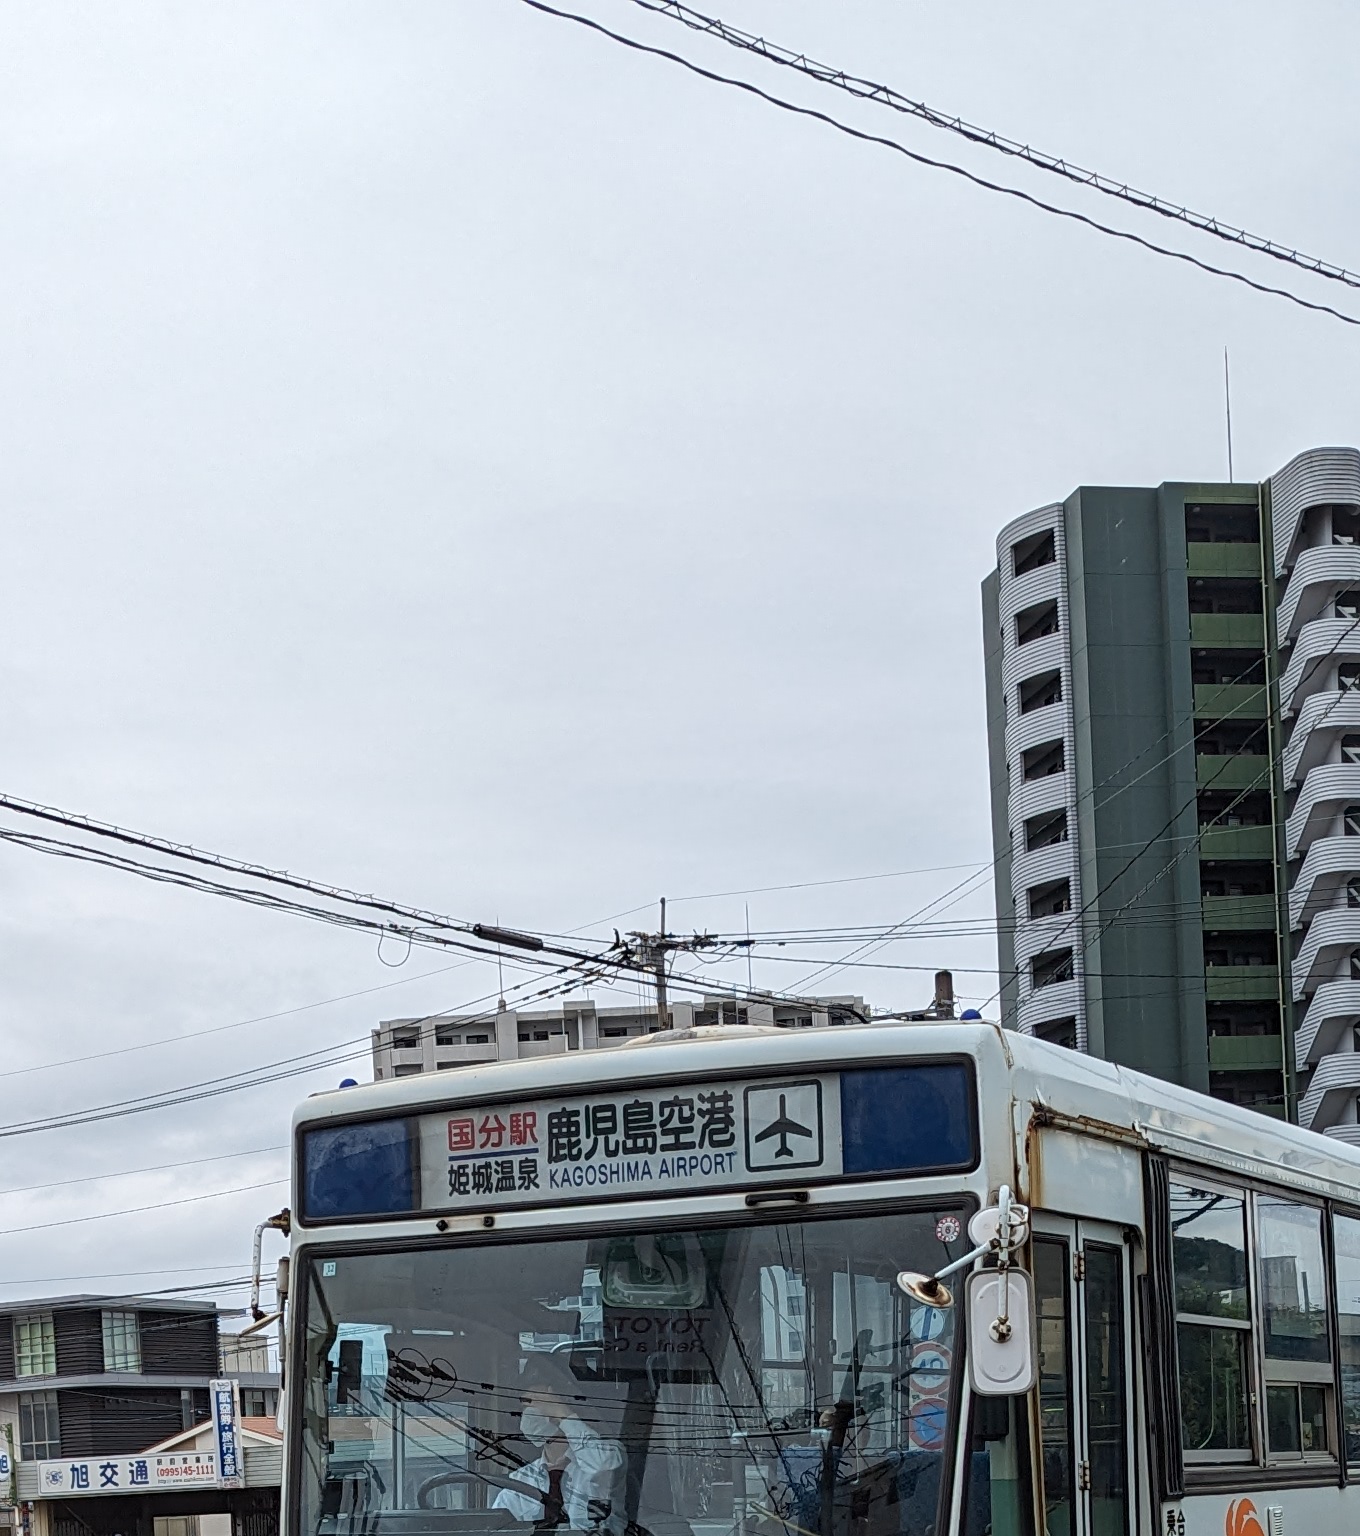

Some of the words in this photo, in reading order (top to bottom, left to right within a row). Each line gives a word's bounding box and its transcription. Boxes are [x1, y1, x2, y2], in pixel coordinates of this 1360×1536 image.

[447, 1111, 538, 1152] 国分駅
[546, 1090, 736, 1164] 鹿児島空港
[447, 1157, 540, 1198] 姫城温泉
[549, 1161, 653, 1189] KAGOSHIMA
[658, 1151, 737, 1180] AIRPORT
[70, 1459, 150, 1489] 旭交通
[156, 1464, 215, 1477] (0995)45-1111
